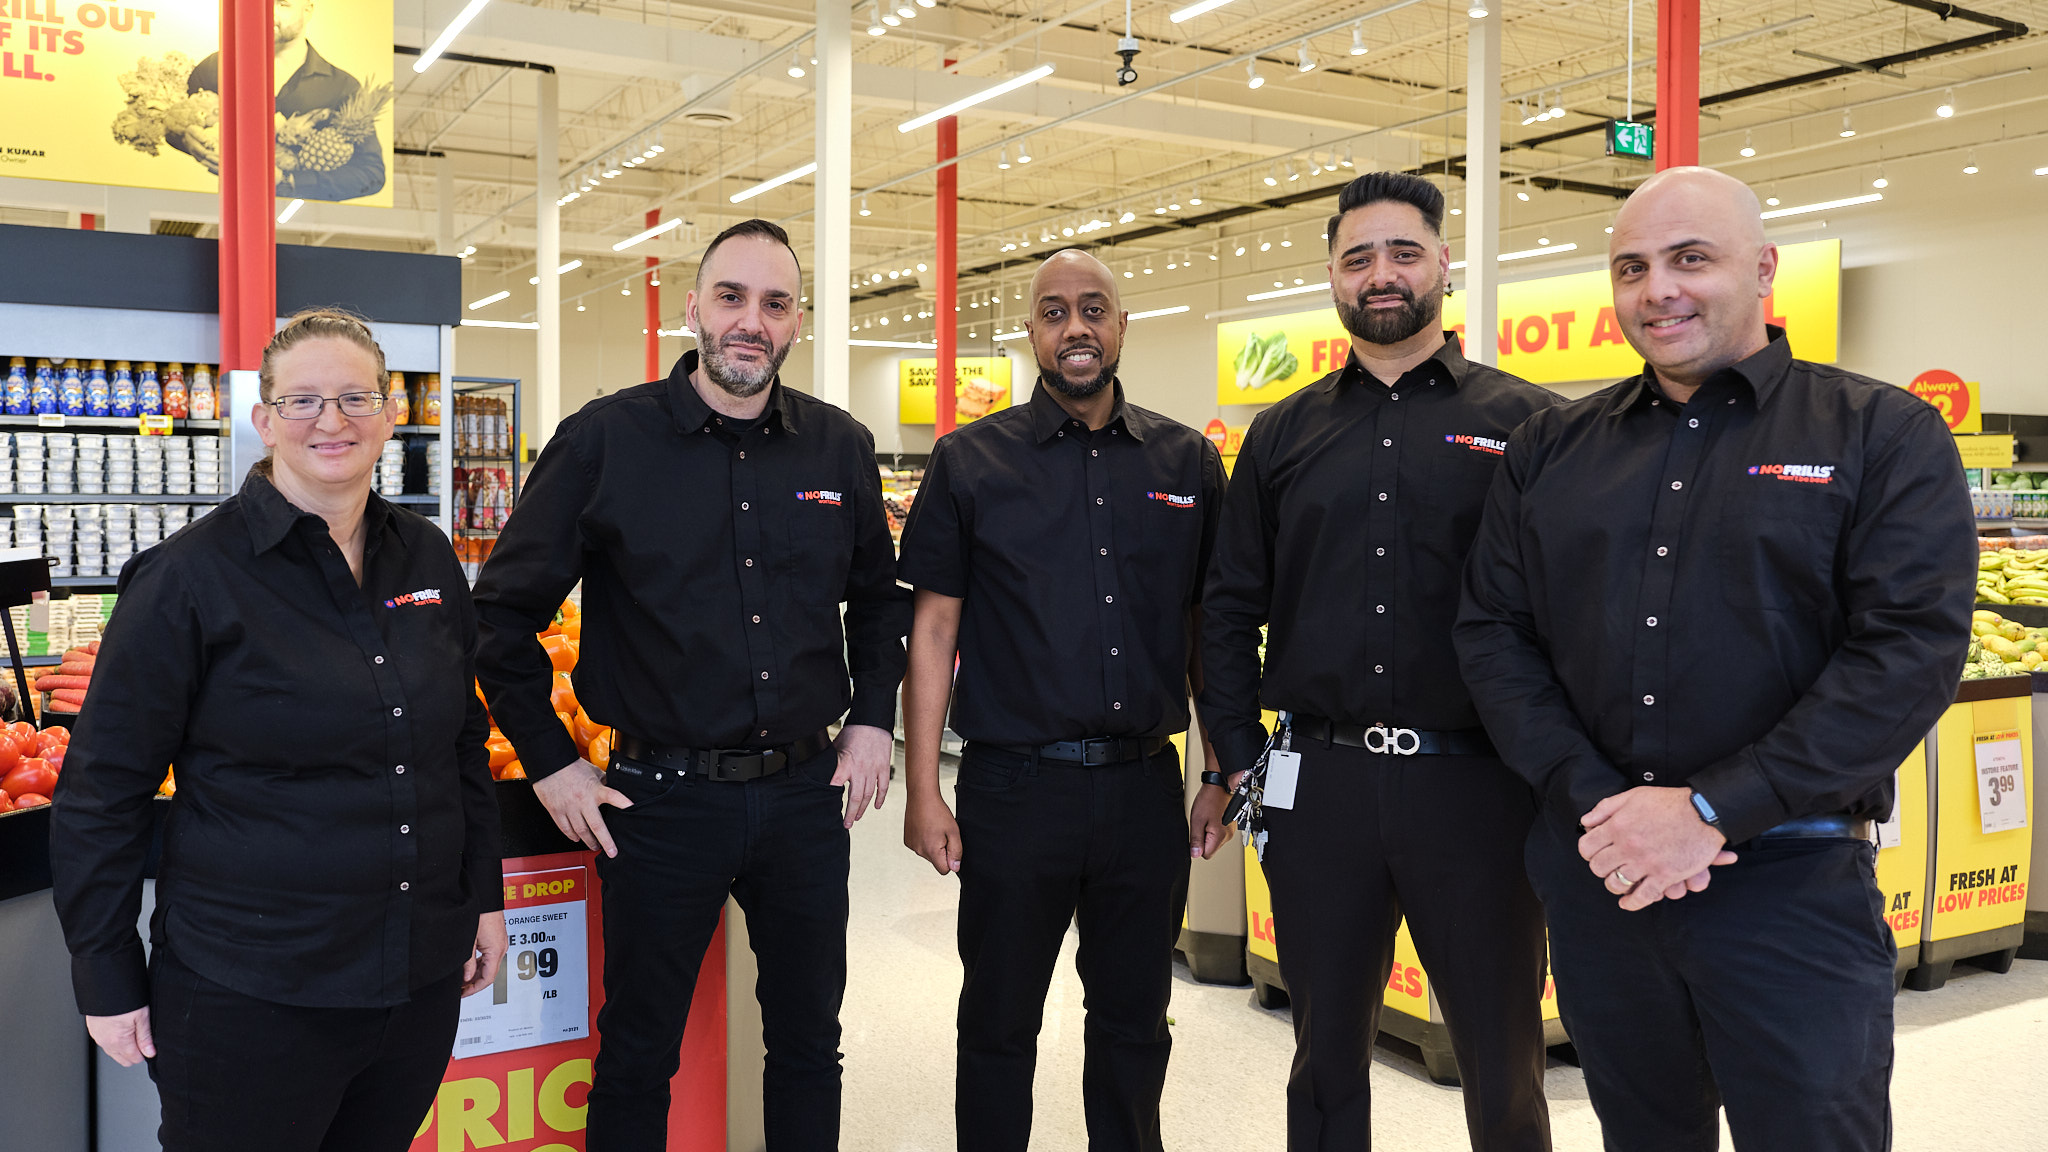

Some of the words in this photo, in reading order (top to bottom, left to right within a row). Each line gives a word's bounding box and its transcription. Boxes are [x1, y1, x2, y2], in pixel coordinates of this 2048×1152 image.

[77, 3, 155, 35] OUT
[29, 25, 85, 55] ITS
[962, 367, 983, 375] THE
[1914, 380, 1960, 395] Always
[1950, 868, 1995, 891] FRESH
[2000, 865, 2018, 883] AT
[523, 879, 575, 899] DROP
[1937, 891, 1974, 914] LOW
[1978, 882, 2026, 908] PRICES
[1891, 891, 1911, 911] AT
[508, 915, 541, 926] ORANGE
[542, 912, 568, 922] SWEET
[543, 989, 558, 1000] /LB
